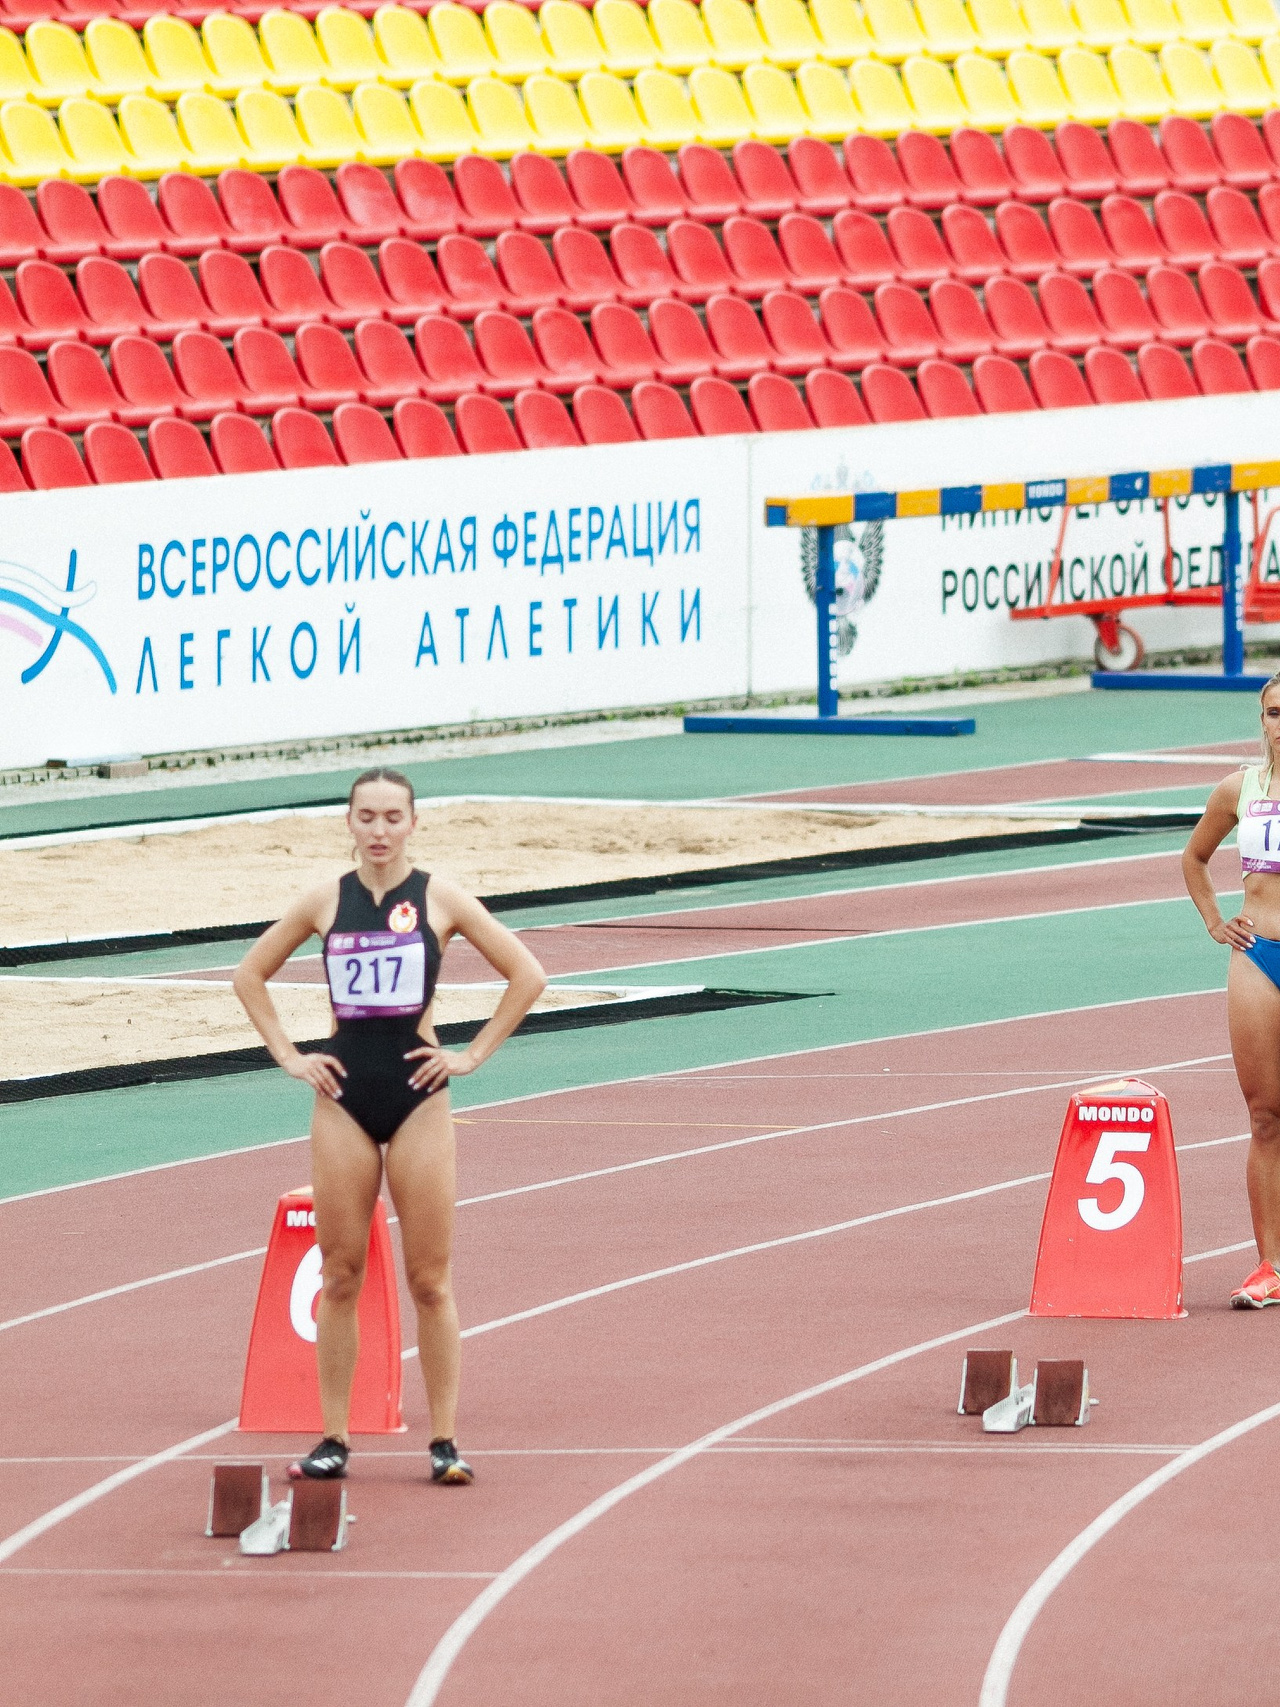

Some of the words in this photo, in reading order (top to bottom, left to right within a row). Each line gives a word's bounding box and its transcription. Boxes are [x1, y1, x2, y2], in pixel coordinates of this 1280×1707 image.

[137, 509, 478, 601] ВСЕРОССИЙСКАЯ
[493, 498, 701, 577] ФЕДЕРАЦИЯ
[941, 539, 1150, 616] РОССИЙСКОЙ
[135, 602, 362, 695] ЛЕГКОЙ
[415, 586, 701, 668] АТЛЕТИКИ
[345, 956, 402, 995] 217
[1078, 1106, 1155, 1123] MONDO
[1077, 1131, 1153, 1232] 5
